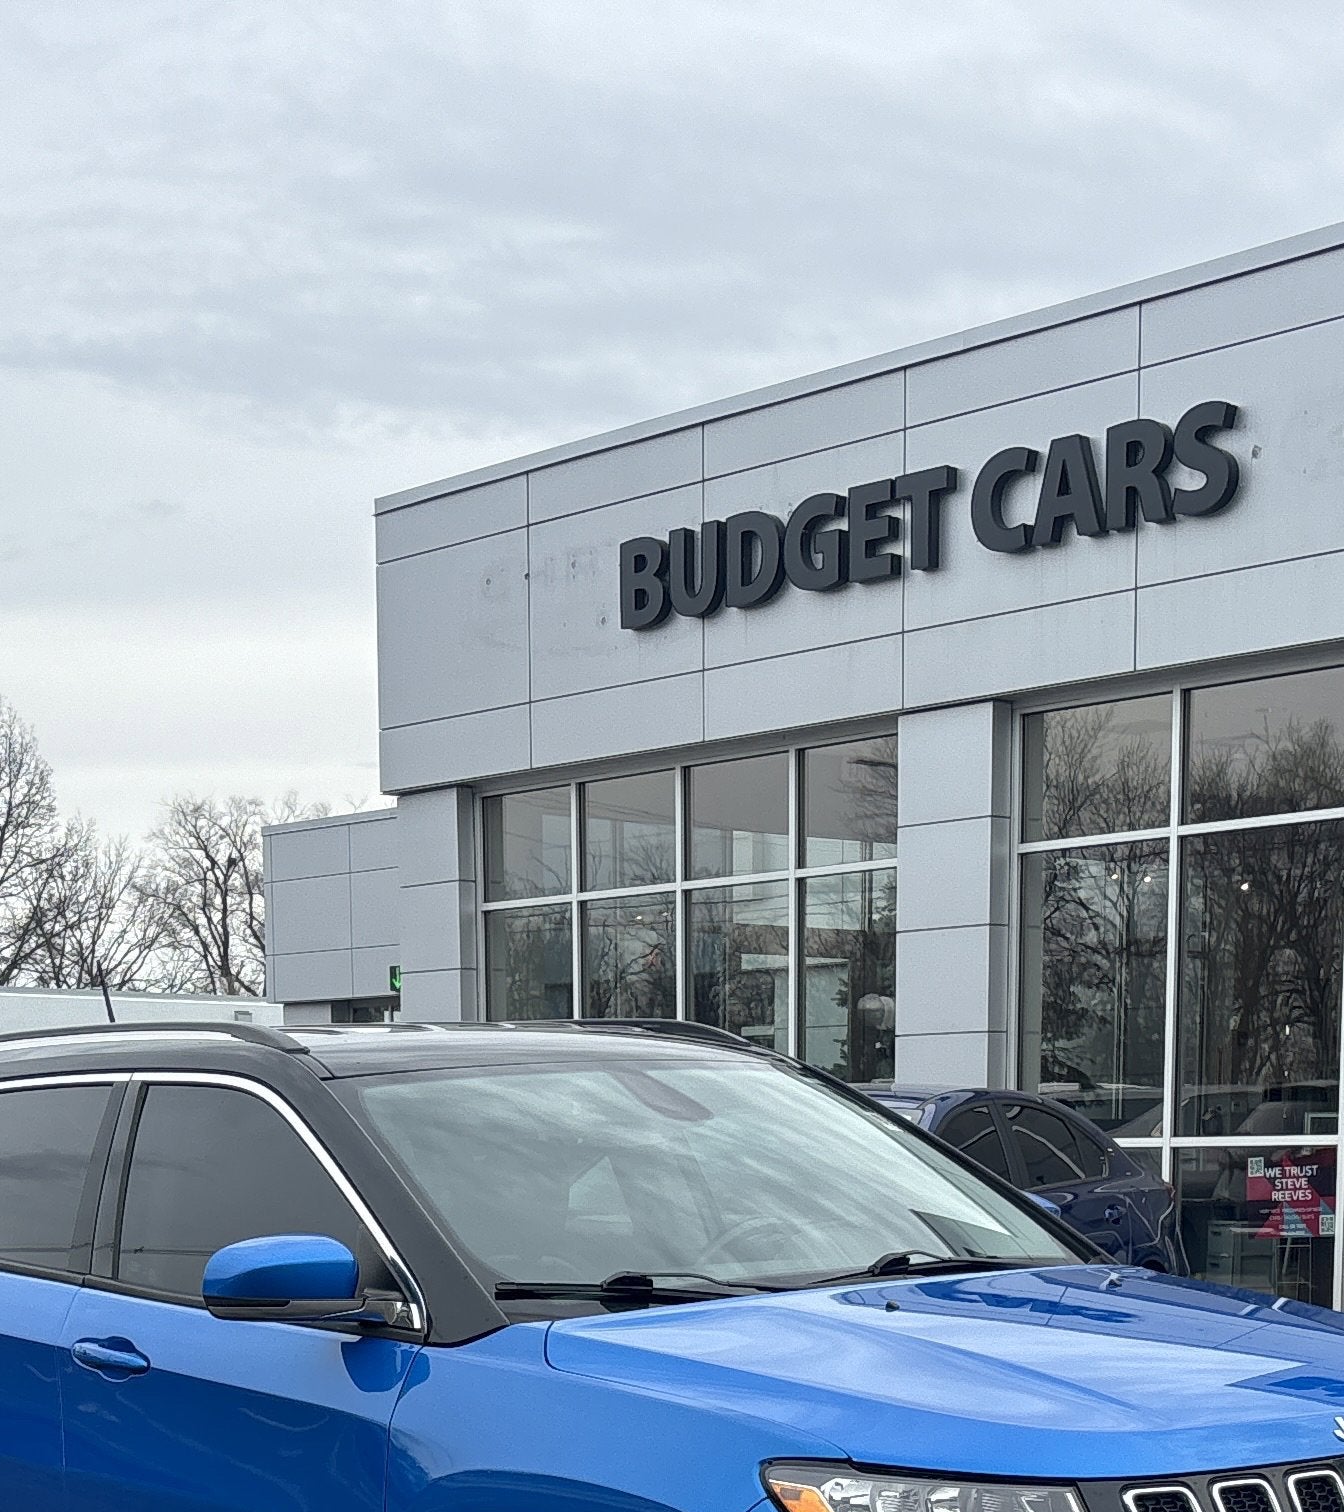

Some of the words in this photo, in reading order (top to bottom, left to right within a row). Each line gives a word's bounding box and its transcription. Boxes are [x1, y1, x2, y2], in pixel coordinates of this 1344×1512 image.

[619, 465, 959, 630] BUDGET
[970, 401, 1240, 554] CARS
[1265, 1167, 1282, 1178] WE
[1284, 1165, 1318, 1177] TRUST
[1274, 1178, 1308, 1189] STEVE
[1271, 1189, 1312, 1201] REEVES
